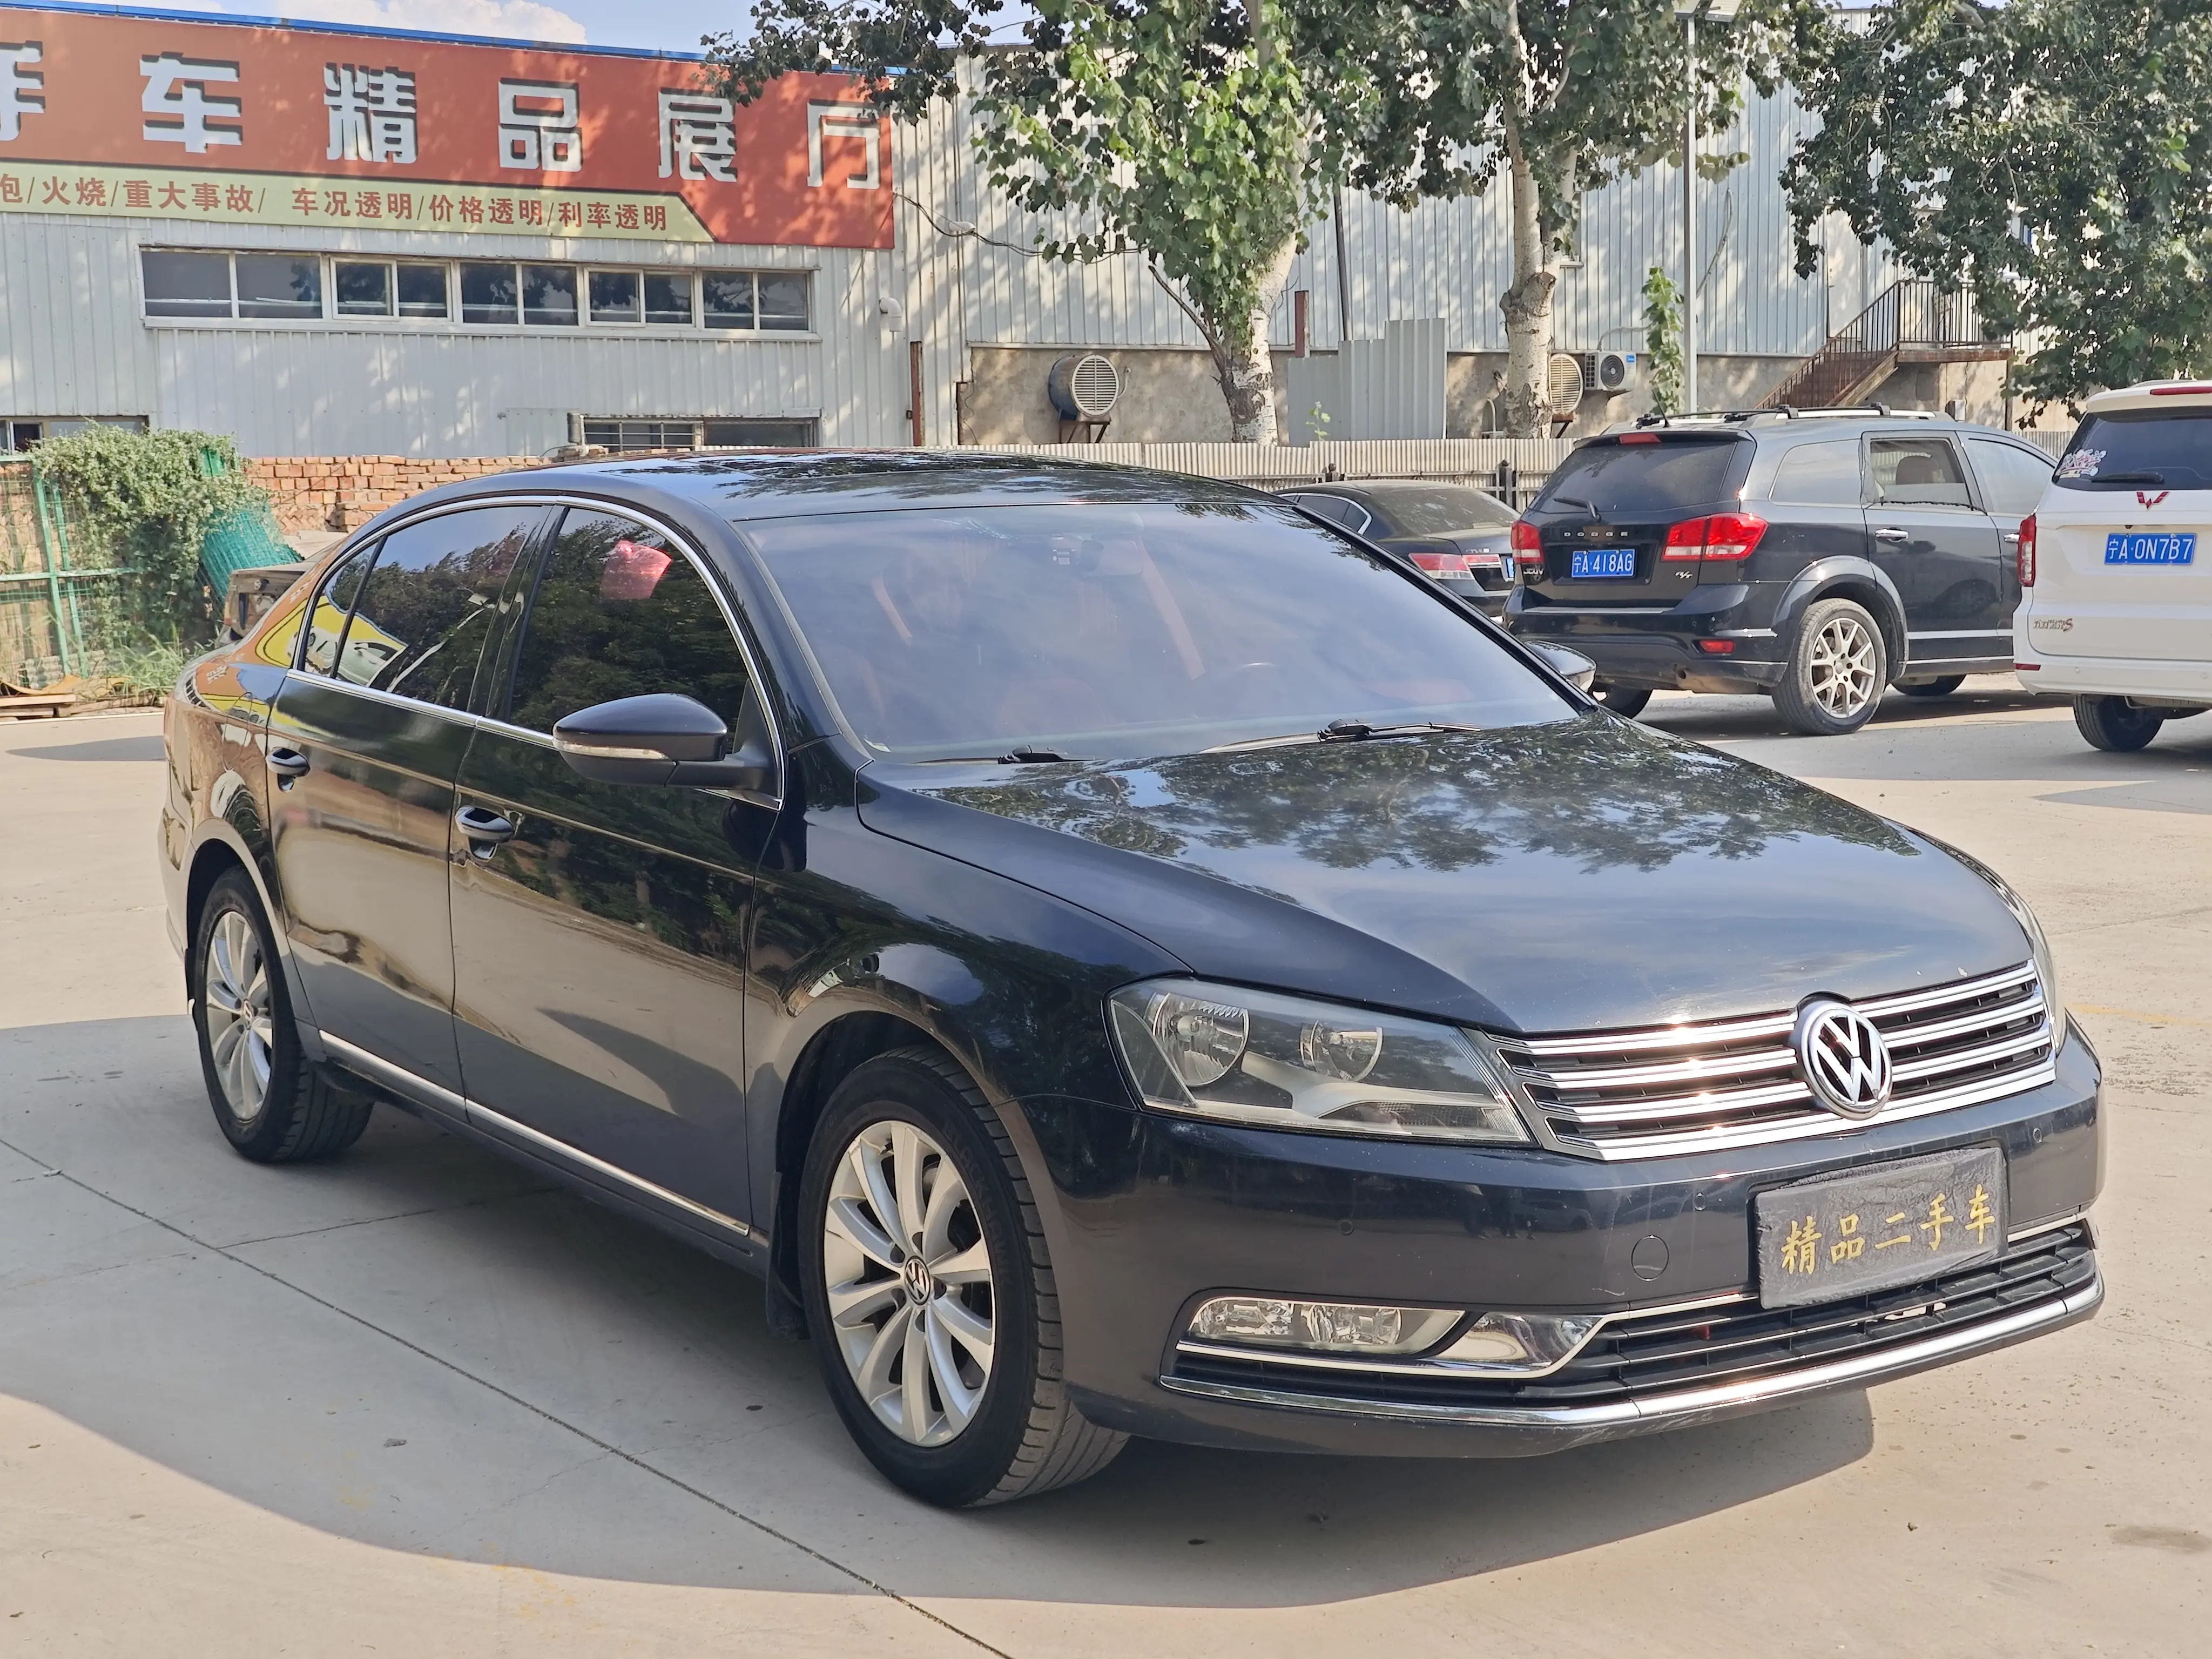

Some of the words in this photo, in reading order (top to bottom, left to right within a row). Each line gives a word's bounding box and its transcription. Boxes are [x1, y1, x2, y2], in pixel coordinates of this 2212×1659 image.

[1781, 1184, 1995, 1275] 精品二手车
